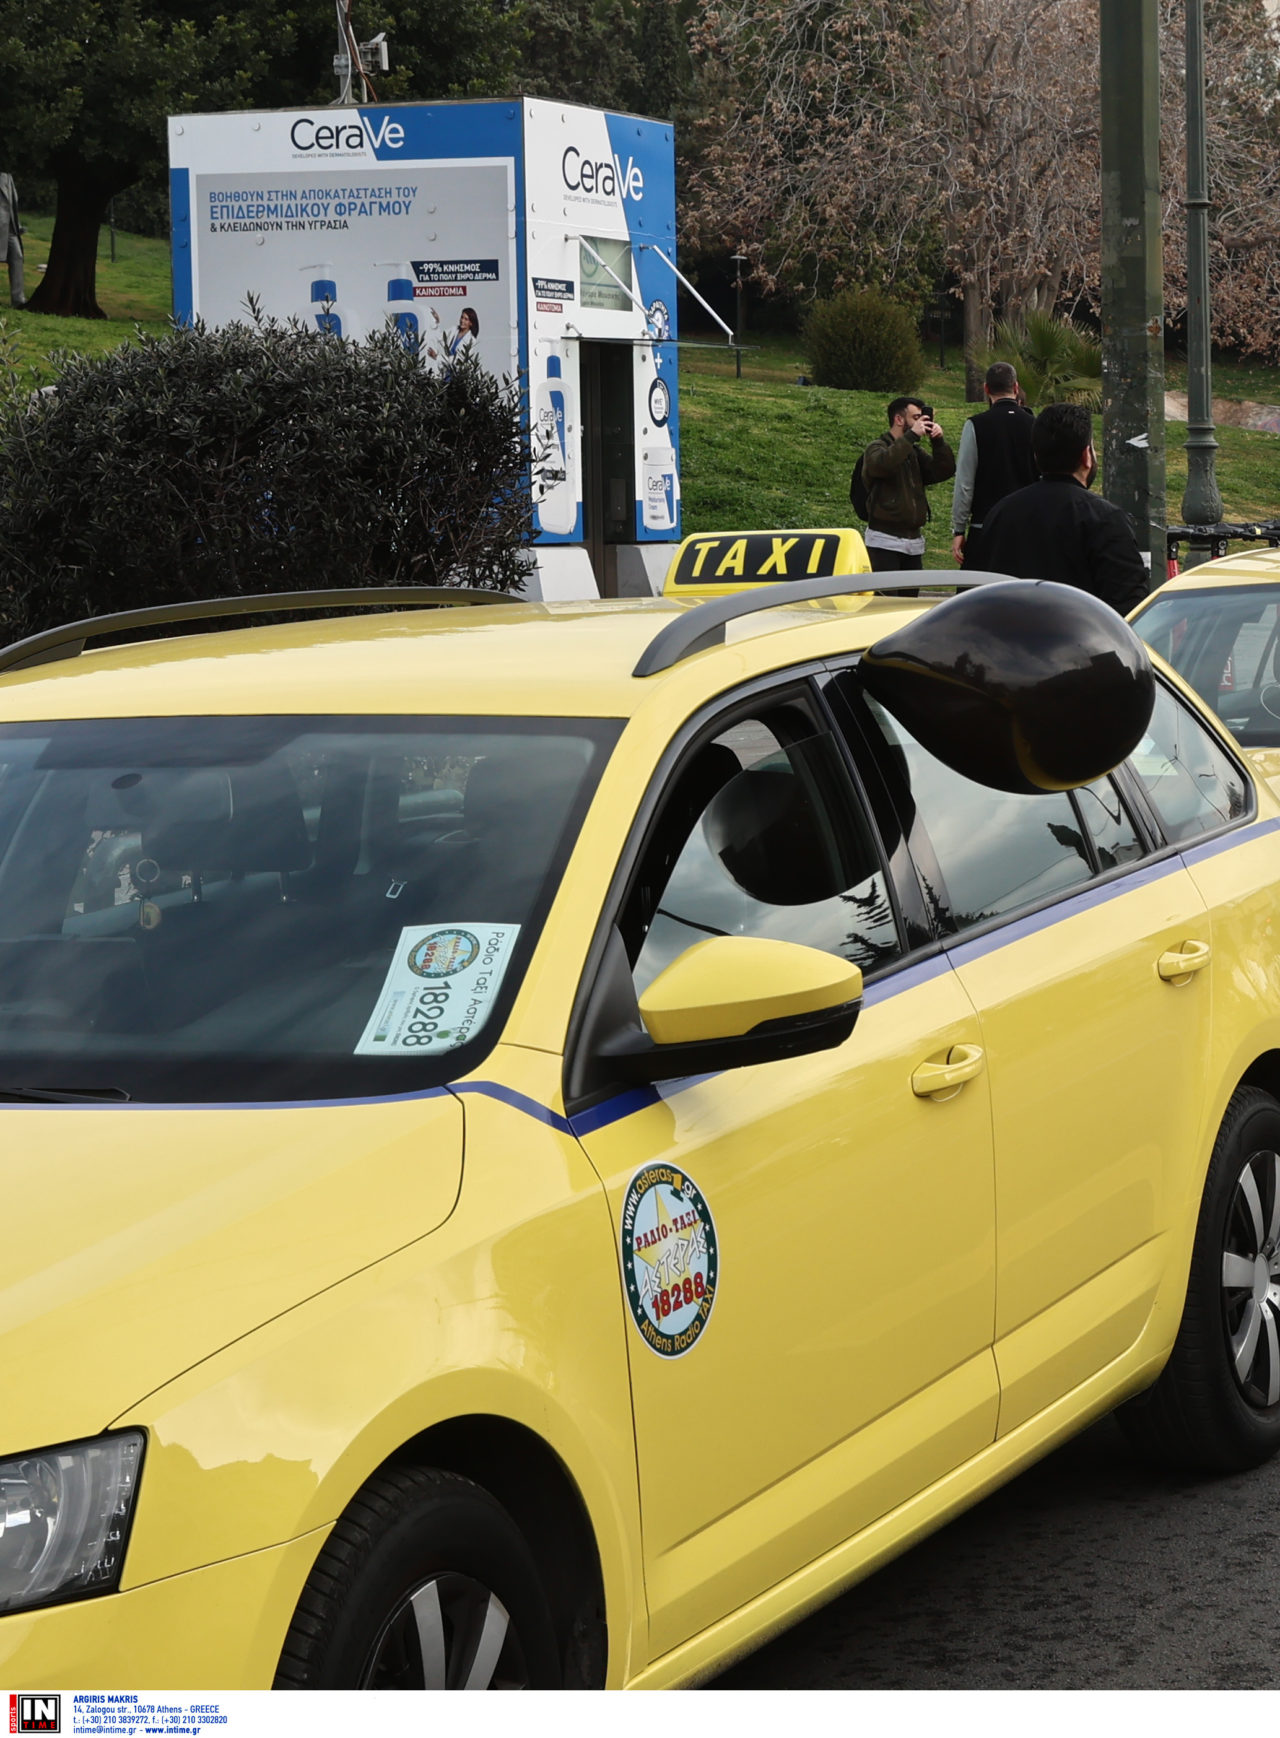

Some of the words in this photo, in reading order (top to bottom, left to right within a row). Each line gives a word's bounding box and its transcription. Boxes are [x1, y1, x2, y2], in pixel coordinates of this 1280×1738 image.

[291, 115, 405, 150] CeraVe
[562, 146, 644, 202] CeraVe
[209, 190, 264, 203] ΒΟΗΘΟΥΝ
[267, 189, 297, 201] ΣΤΗΝ
[300, 187, 393, 201] ΑΠΟΚΑΤΑΣΤΑΣΗ
[395, 186, 418, 199] ΤΟΥ
[210, 202, 330, 220] ΕΠΙΔΕΡΜΙΔΙΚΟΥ
[334, 200, 412, 217] ΦΡΑΓΜΟΥ
[210, 223, 218, 233] &
[219, 221, 283, 233] ΚΛΕΙΔΩΝΟΥΝ
[284, 220, 306, 231] ΤΗΝ
[307, 219, 349, 231] ΥΓΡΑΣΙΑ
[419, 263, 442, 273] -99%
[443, 263, 481, 272] ΚΝΗΣΜΟΣ
[474, 272, 497, 280] ΔΕΡΜΑ
[415, 287, 464, 297] ΚΑΙΝΟΤΟΜΙΑ
[692, 537, 826, 577] TAXI
[402, 980, 453, 1048] 18288
[651, 1271, 706, 1321] 18288
[640, 1319, 673, 1352] Athens
[674, 1321, 701, 1351] Radio
[698, 1285, 715, 1320] TAXI
